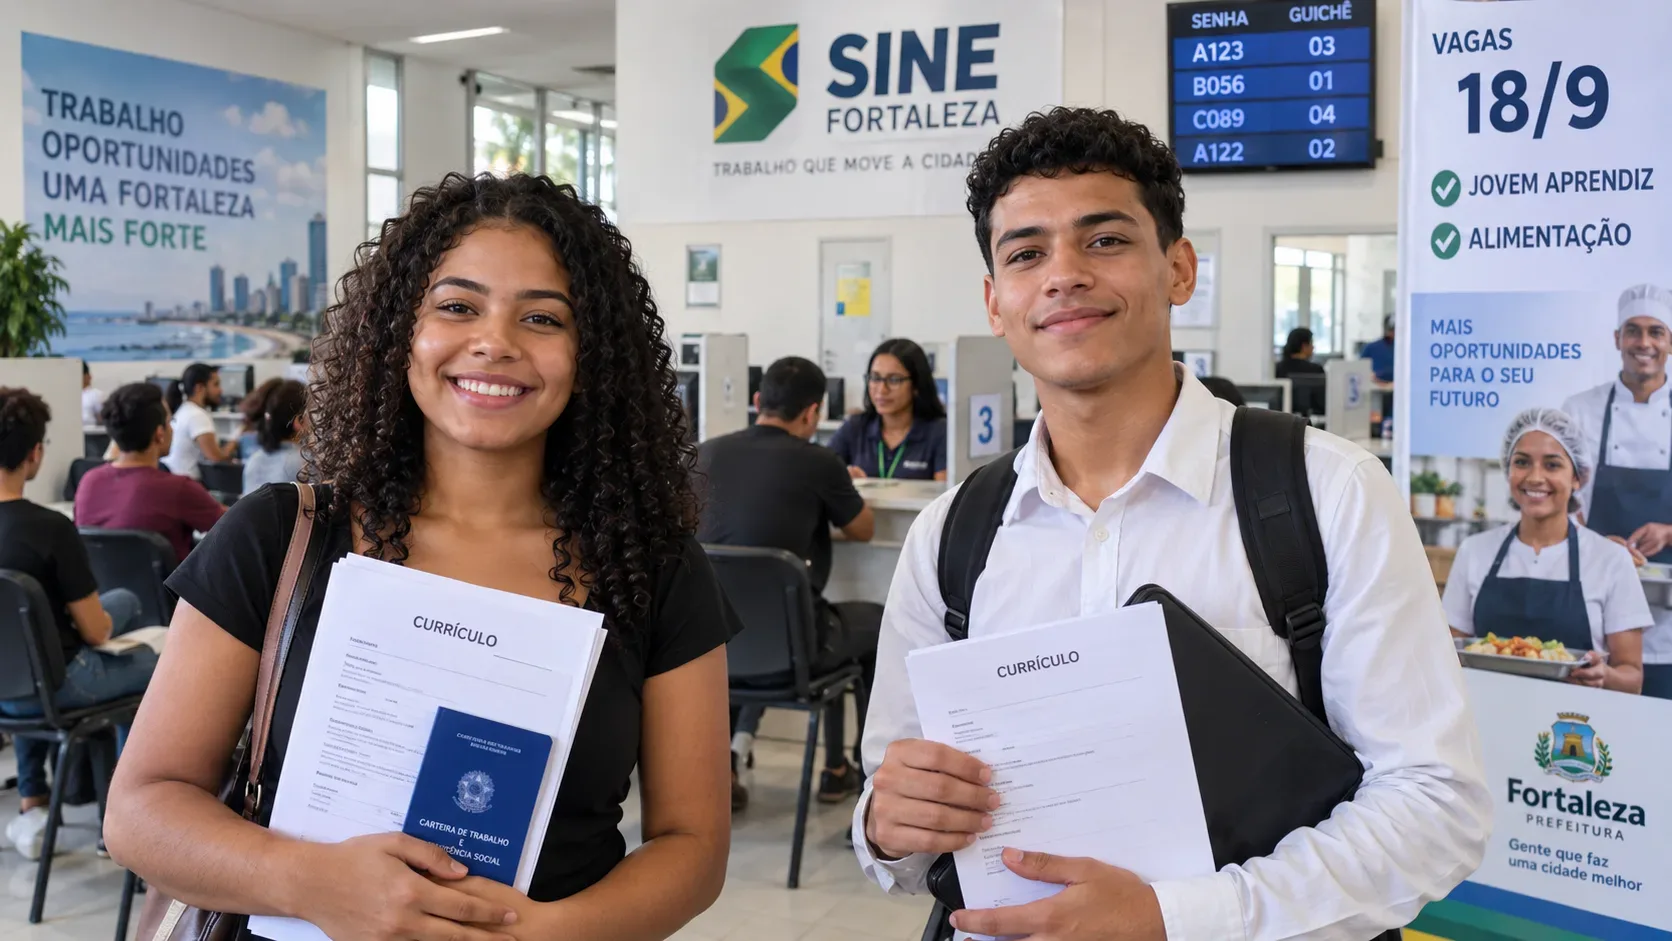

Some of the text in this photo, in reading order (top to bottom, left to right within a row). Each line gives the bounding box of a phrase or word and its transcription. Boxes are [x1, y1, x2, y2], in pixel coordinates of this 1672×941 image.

[1191, 0, 1352, 29] SENHA GUICHÊ
[1192, 36, 1336, 62] A123 03
[1432, 27, 1513, 55] VAGAS
[826, 23, 1000, 99] SINE
[1193, 71, 1333, 96] B056 01
[41, 88, 184, 137] TRABALHO
[1457, 61, 1609, 139] 18/9
[827, 101, 1000, 133] FORTALEZA
[1193, 104, 1336, 129] C089 04
[42, 130, 255, 184] OPORTUNIDADES
[713, 152, 977, 177] TRABALHO QUE MOVE A CIDAD
[1192, 139, 1336, 163] A122 02
[43, 171, 255, 218] UMA FORTALEZA
[1468, 168, 1654, 196] JOVEM APRENDIZ
[44, 212, 207, 250] MAIS FORTE
[1468, 218, 1631, 253] ALIMENTAÇÃO
[1431, 319, 1473, 335] MAIS
[1430, 343, 1582, 360] OPORTUNIDADES
[1430, 366, 1534, 384] PARA O SEU
[1430, 390, 1500, 408] FUTURO
[978, 405, 993, 445] 3
[413, 615, 498, 648] CURRÍCULO
[997, 650, 1080, 678] CURRÍCULO
[1507, 777, 1646, 826] Fortaleza
[419, 818, 456, 834] CARTEIRA
[457, 827, 467, 837] DE
[469, 830, 510, 847] TRABALHO
[1526, 813, 1624, 841] PREFEITURA
[459, 839, 464, 847] E
[1508, 838, 1609, 868] Gente que faz
[473, 853, 501, 866] SOCIAL
[1508, 857, 1642, 891] uma cidade melhor
